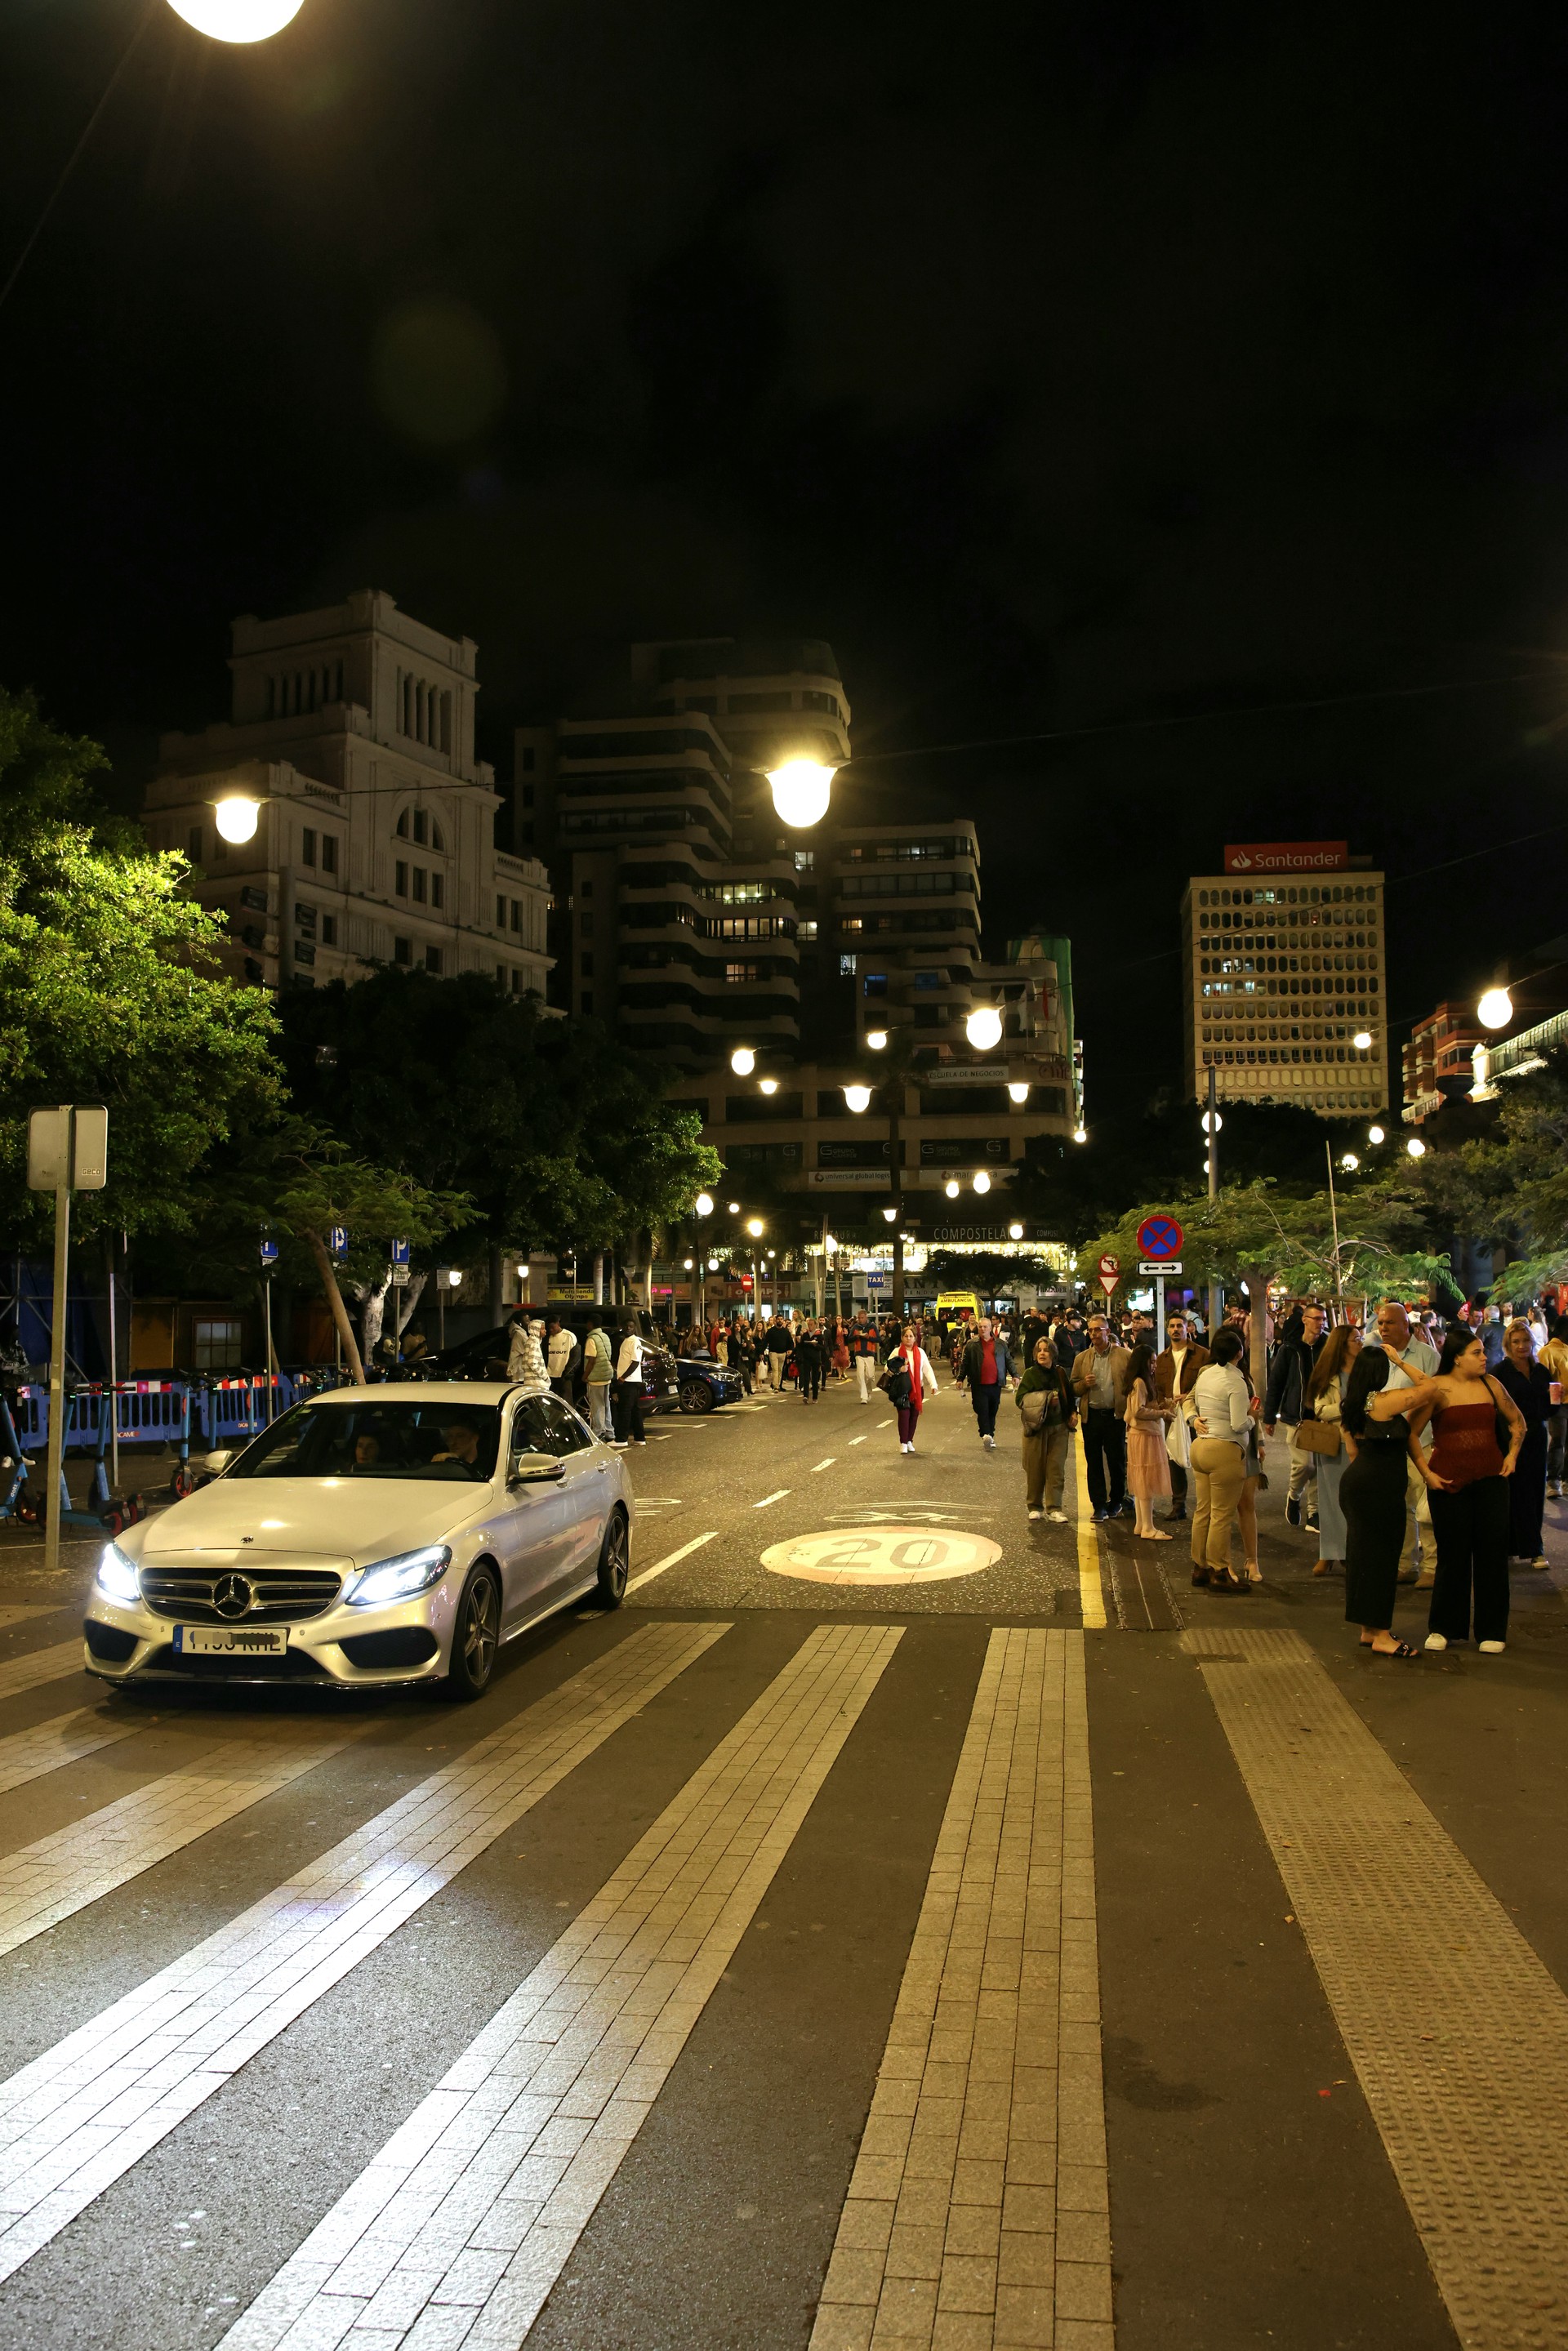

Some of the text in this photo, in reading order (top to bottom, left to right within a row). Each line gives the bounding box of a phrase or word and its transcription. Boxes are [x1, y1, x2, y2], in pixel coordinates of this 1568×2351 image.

[1255, 852, 1342, 867] Santander
[855, 1173, 874, 1181] global
[10, 1483, 19, 1498] dott
[814, 1538, 950, 1569] 20
